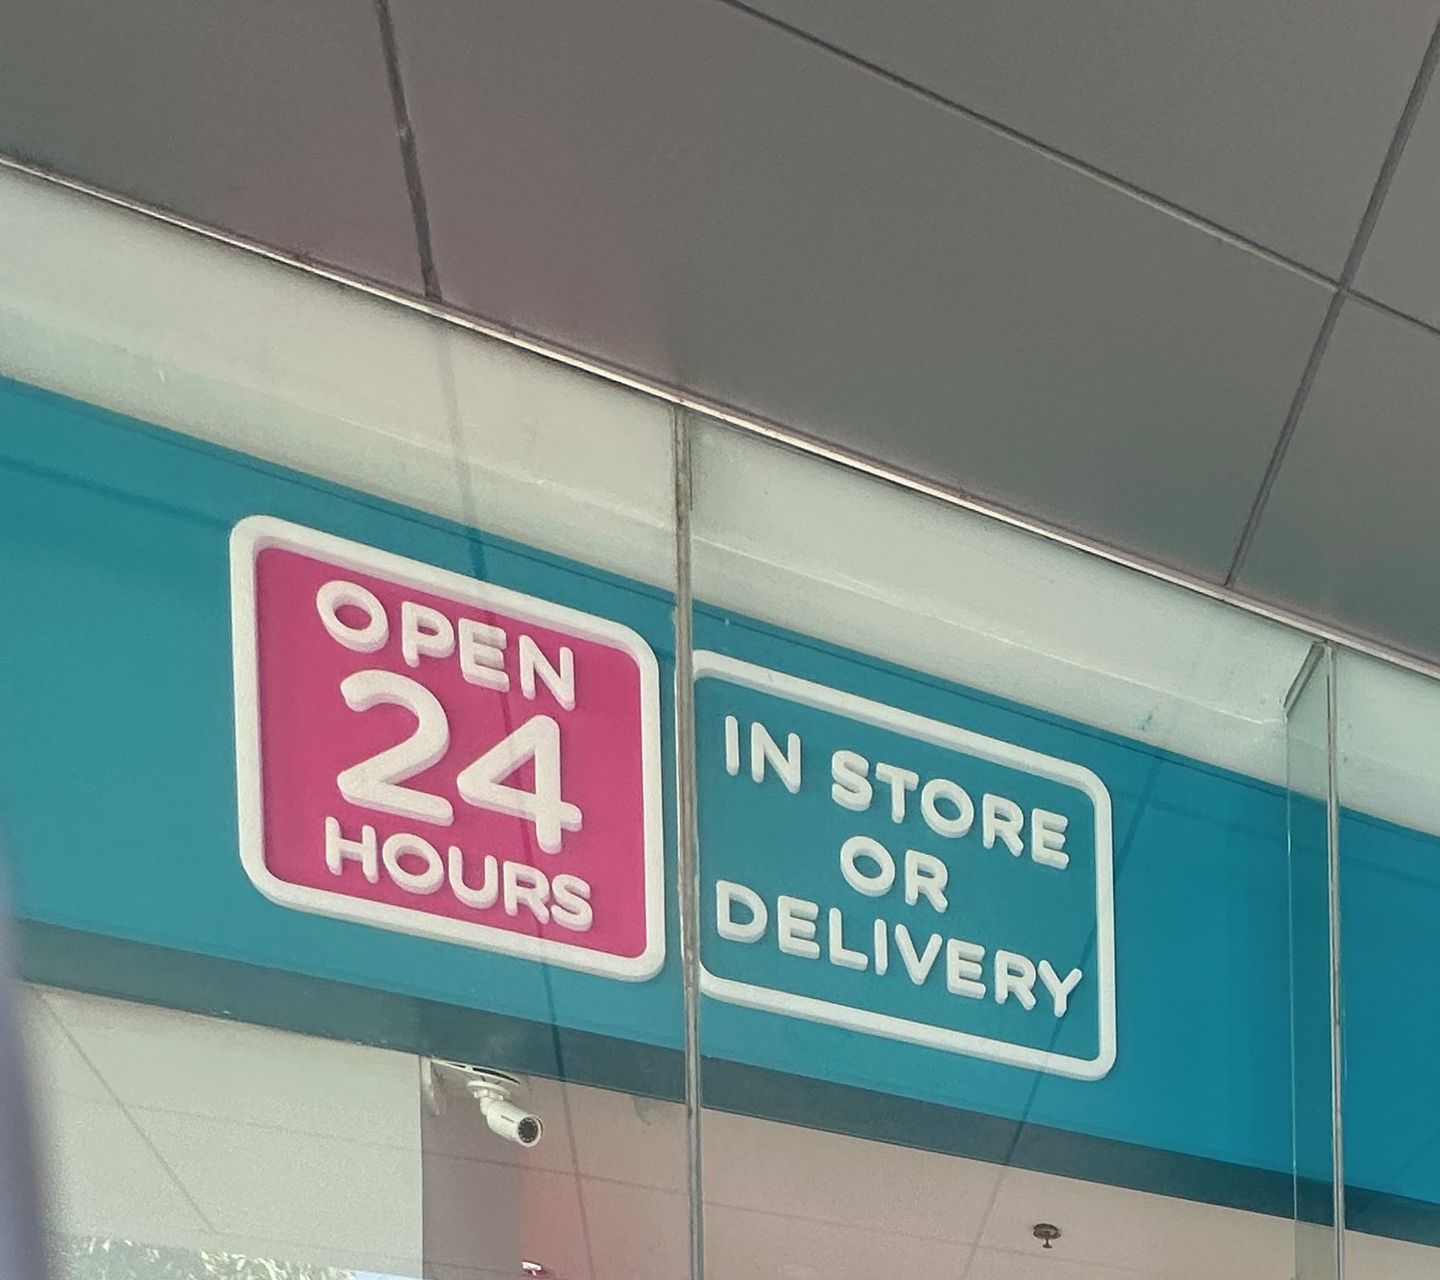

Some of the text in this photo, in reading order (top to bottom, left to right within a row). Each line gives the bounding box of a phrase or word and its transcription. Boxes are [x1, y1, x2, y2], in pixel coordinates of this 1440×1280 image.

[316, 581, 575, 710] OPEN
[336, 670, 582, 854] 24
[725, 715, 1070, 870] IN STORE
[324, 817, 593, 932] HOURS
[840, 835, 950, 913] OR
[716, 879, 1083, 1019] DELIVERY
